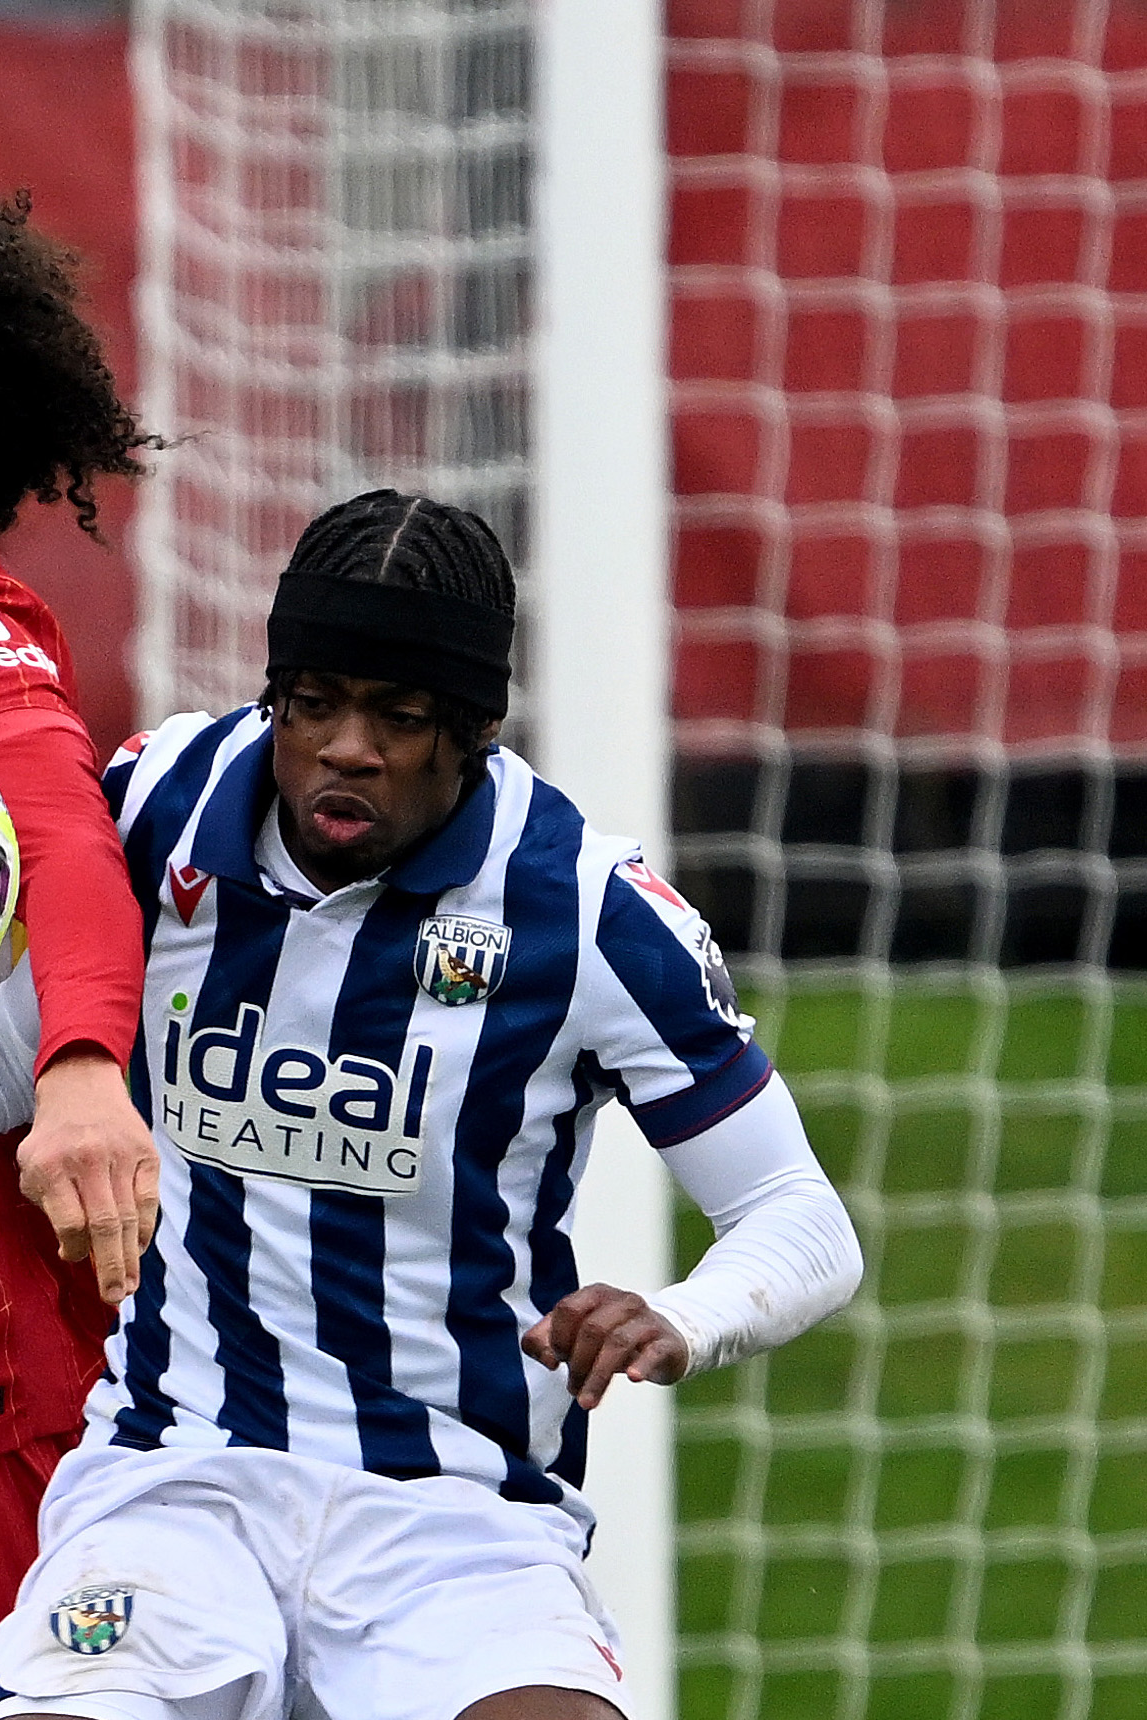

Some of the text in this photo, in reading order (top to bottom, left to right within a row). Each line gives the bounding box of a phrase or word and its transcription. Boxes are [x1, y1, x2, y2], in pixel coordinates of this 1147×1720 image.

[426, 924, 503, 950] ALBION
[164, 992, 433, 1139] ideal
[163, 1094, 418, 1180] HEATING
